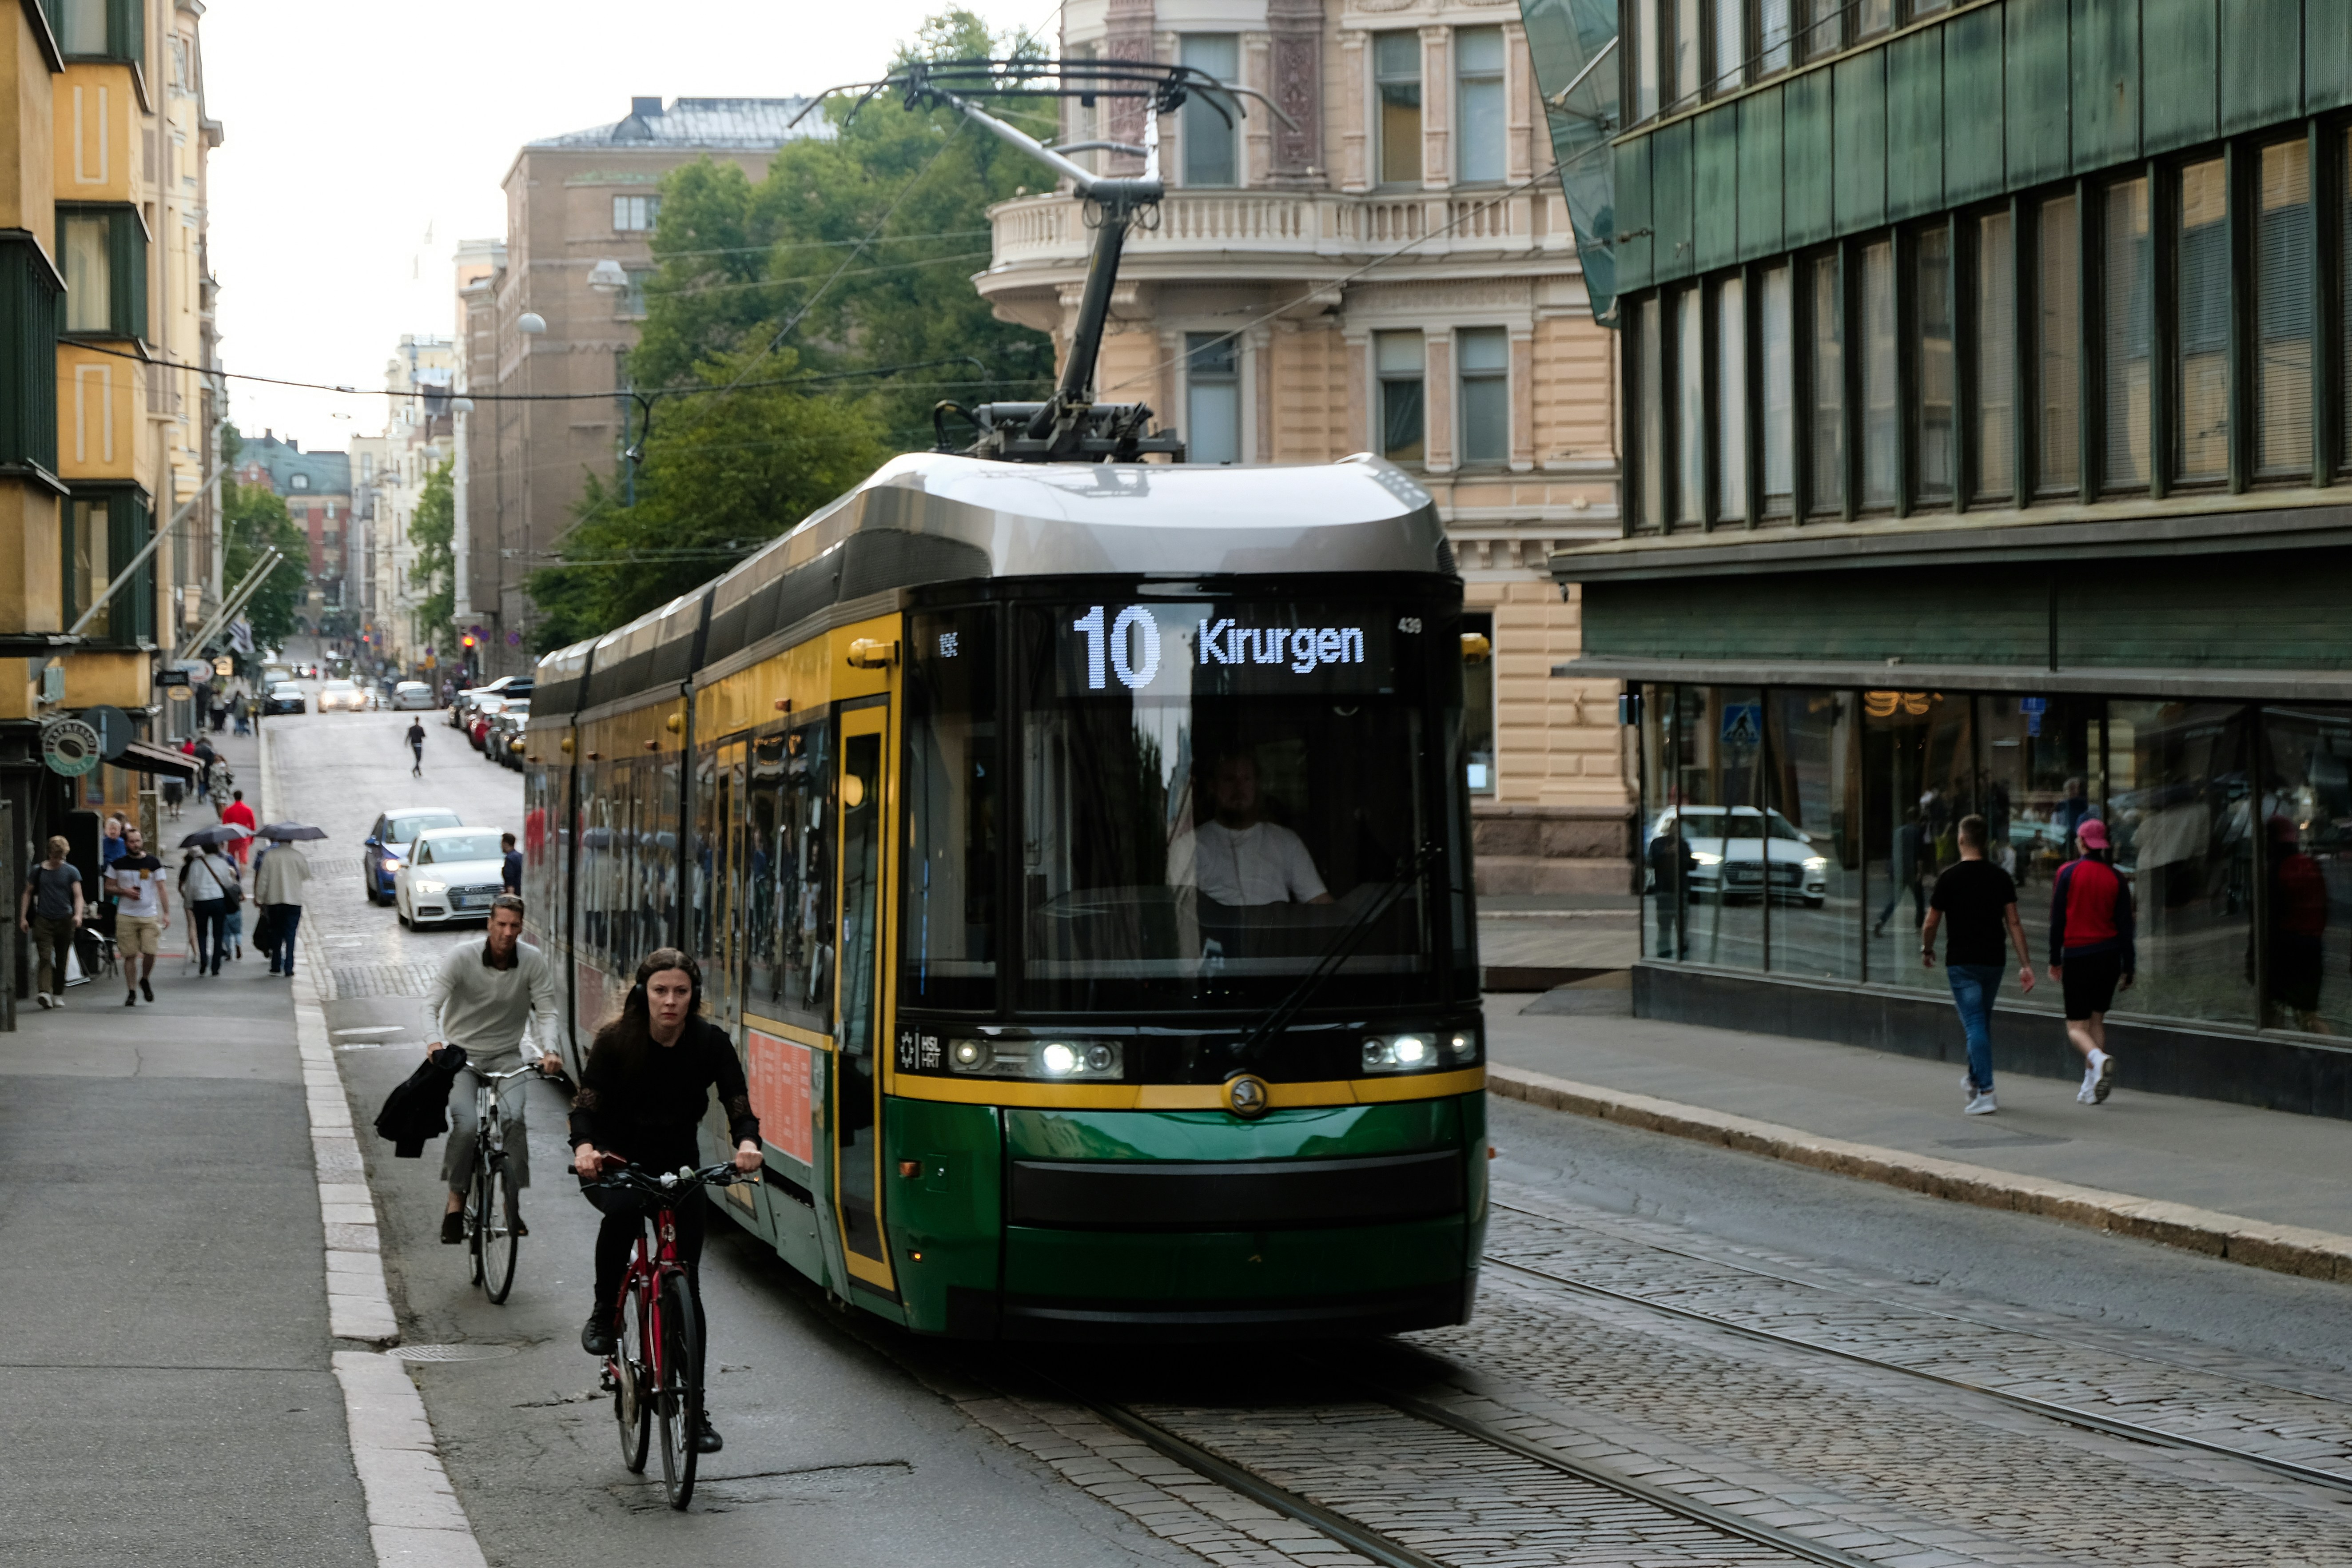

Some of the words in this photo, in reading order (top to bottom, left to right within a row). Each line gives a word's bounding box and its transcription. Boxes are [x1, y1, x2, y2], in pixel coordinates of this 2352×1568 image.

[1073, 605, 1161, 688] 10
[1199, 619, 1364, 673] Kirurgen
[921, 1035, 941, 1052] HSL
[921, 1052, 941, 1068] HRT
